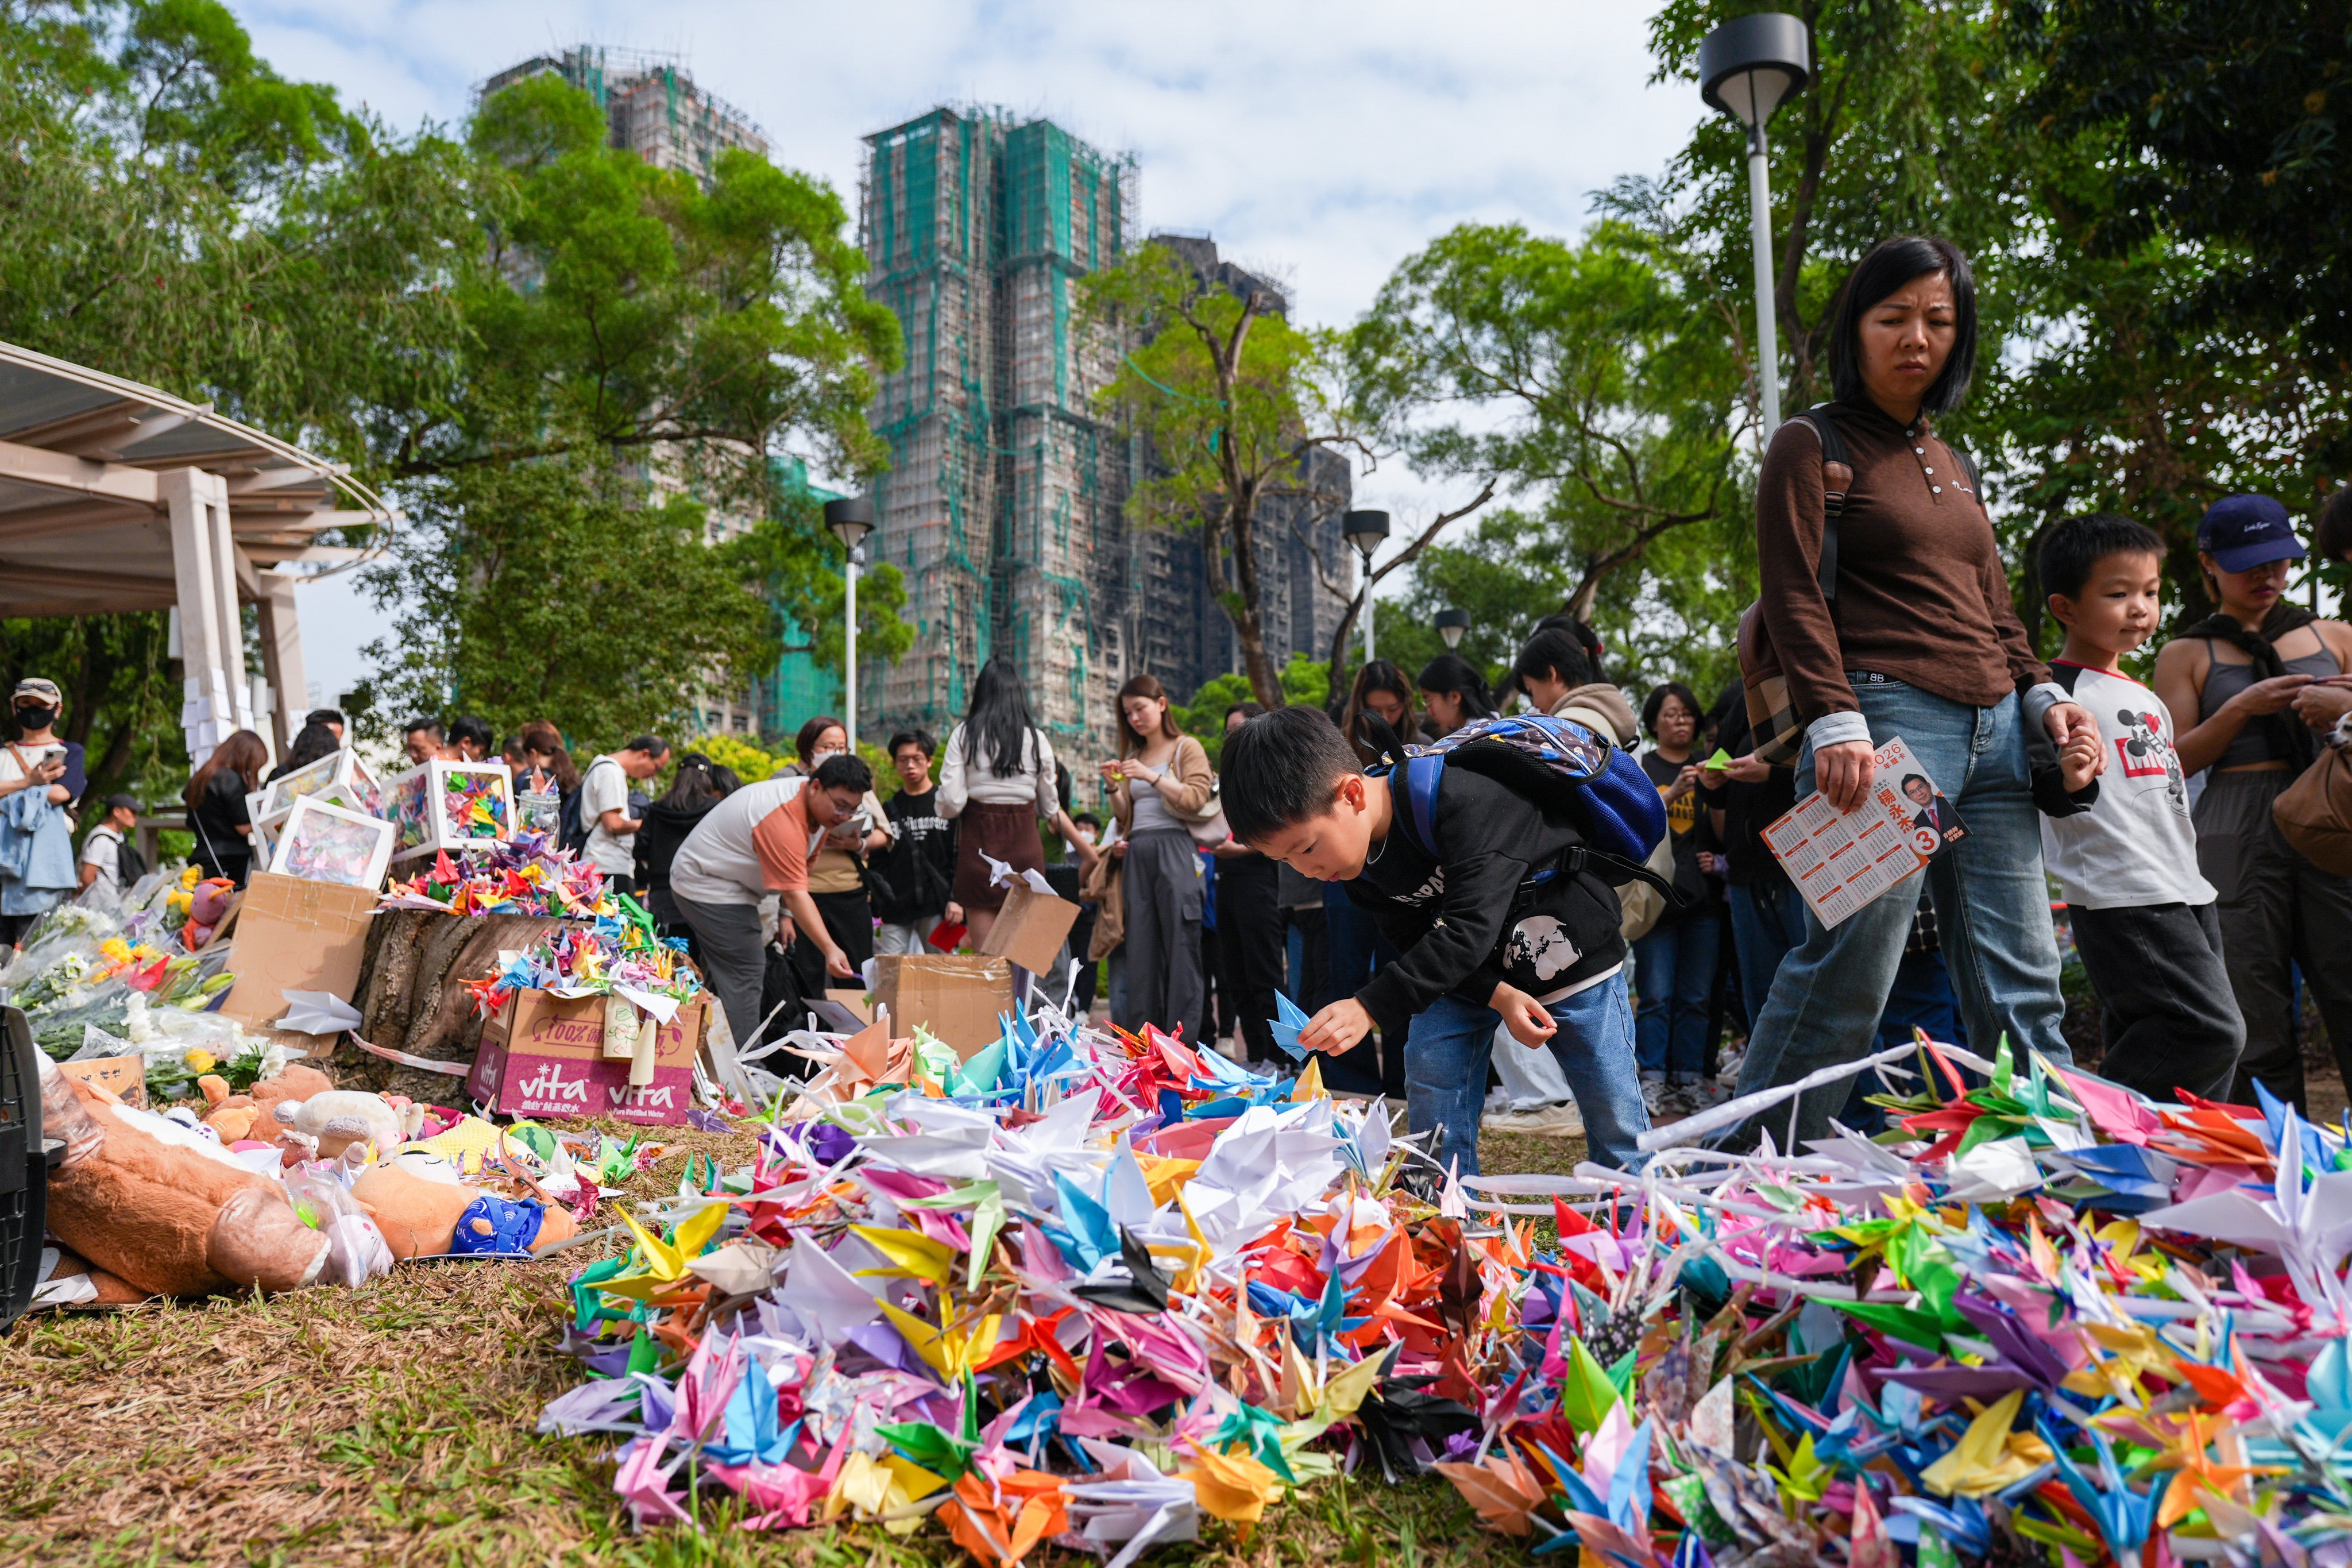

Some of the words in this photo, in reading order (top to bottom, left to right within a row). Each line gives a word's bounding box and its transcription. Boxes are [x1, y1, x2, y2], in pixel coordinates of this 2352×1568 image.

[1874, 743, 1901, 769] 026
[1883, 754, 1906, 770] 年曆卡
[1876, 787, 1917, 835] 楊永杰
[1915, 831, 1936, 851] 3
[519, 1063, 588, 1103] vita
[609, 1084, 674, 1109] vita
[648, 1110, 666, 1118] Water
